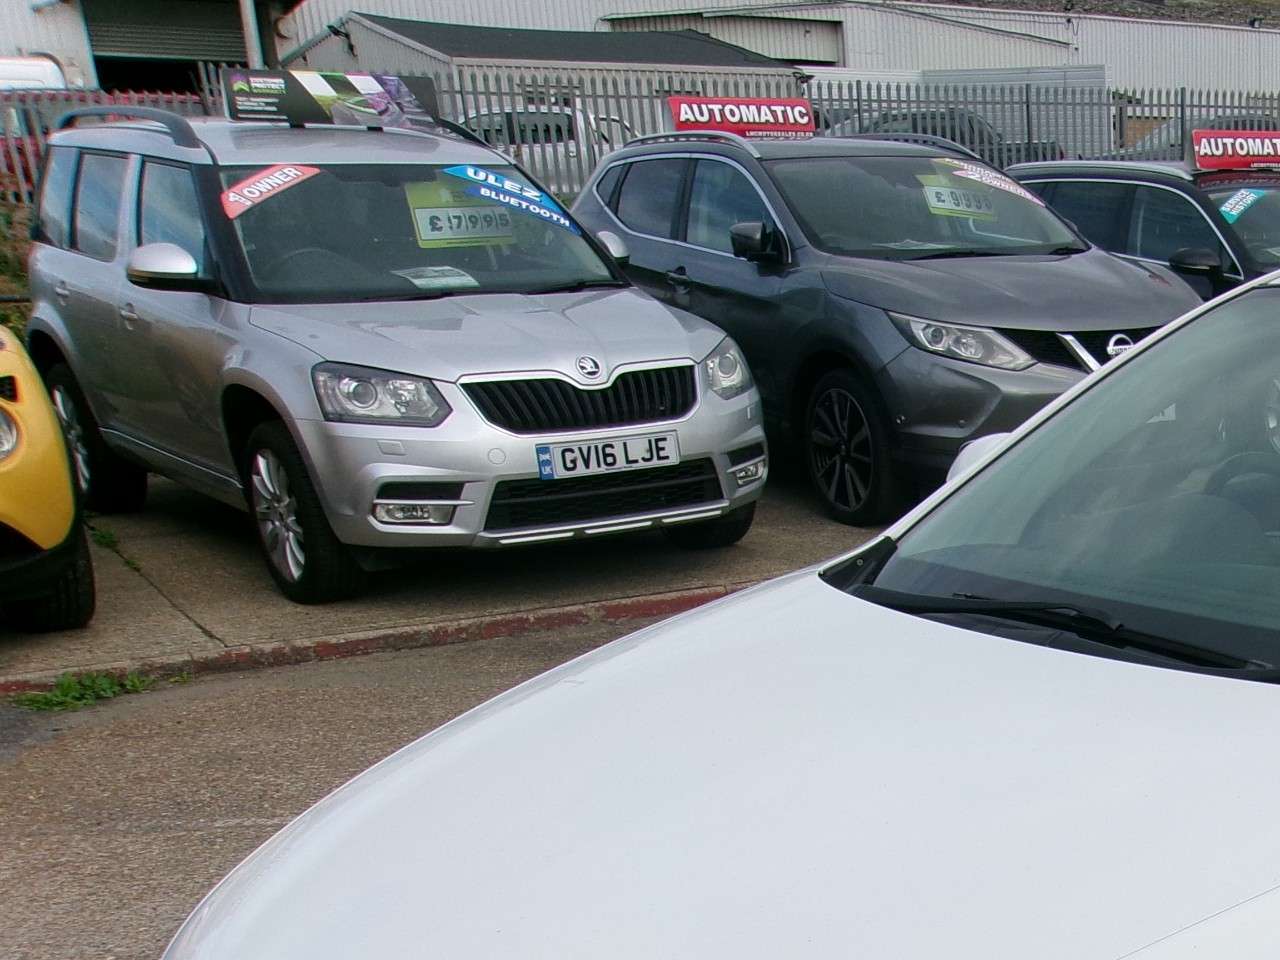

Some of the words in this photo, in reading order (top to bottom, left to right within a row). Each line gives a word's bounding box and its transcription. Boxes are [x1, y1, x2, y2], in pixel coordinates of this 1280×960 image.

[679, 103, 809, 125] AUTOMATIC
[242, 167, 304, 198] OWNER
[466, 167, 543, 201] ULEZ
[480, 187, 570, 227] BLUETOOTH
[560, 443, 617, 472] GV16
[623, 437, 670, 465] LJE
